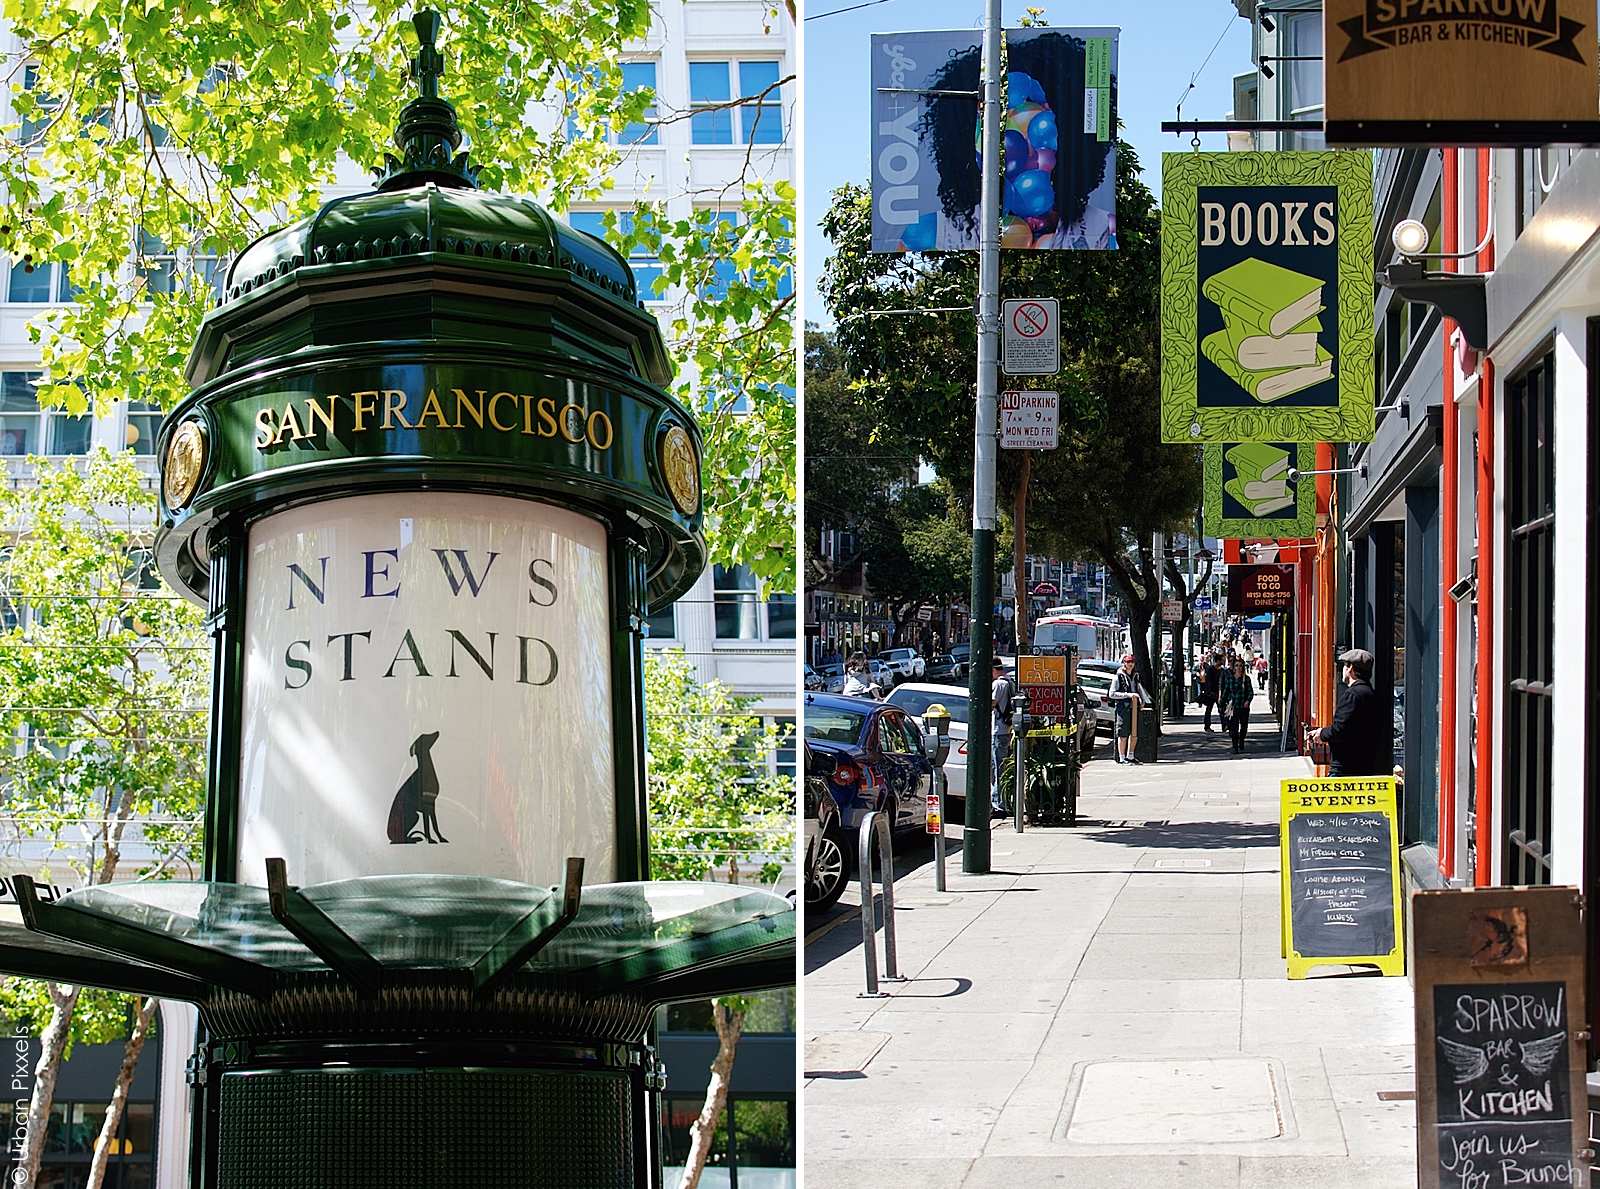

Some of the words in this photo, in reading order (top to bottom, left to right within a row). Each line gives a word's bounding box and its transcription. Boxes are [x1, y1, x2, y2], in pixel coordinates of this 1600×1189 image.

[1398, 25, 1432, 46] BAR
[1437, 23, 1450, 40] &
[1455, 23, 1525, 46] KITCHEN
[878, 107, 920, 225] YOU
[1200, 202, 1337, 247] BOOKS
[1003, 393, 1019, 408] NO
[1021, 397, 1056, 408] PARKING
[255, 394, 339, 450] SAN
[351, 388, 614, 451] FRANCISCO
[1006, 427, 1022, 436] MON
[1024, 427, 1039, 436] WED
[1041, 427, 1053, 436] FRI
[285, 548, 559, 611] NEWS
[284, 629, 560, 690] STAND
[1033, 658, 1049, 670] EL
[1026, 670, 1059, 683] FARO
[1035, 700, 1063, 713] Food
[1288, 782, 1389, 793] BOOKSMITH
[1301, 795, 1376, 806] EVENTS
[1330, 816, 1348, 827] 4/16
[1350, 887, 1365, 895] THE
[1327, 914, 1354, 922] ILLNESS
[1456, 988, 1564, 1033] SPARROW
[1485, 1038, 1516, 1059] BAR
[1498, 1064, 1519, 1086] &
[1459, 1081, 1554, 1120] KITCHEN
[1441, 1130, 1494, 1171] Join
[1500, 1134, 1540, 1155] us
[1456, 1159, 1490, 1189] for
[1498, 1159, 1582, 1187] Brunch
